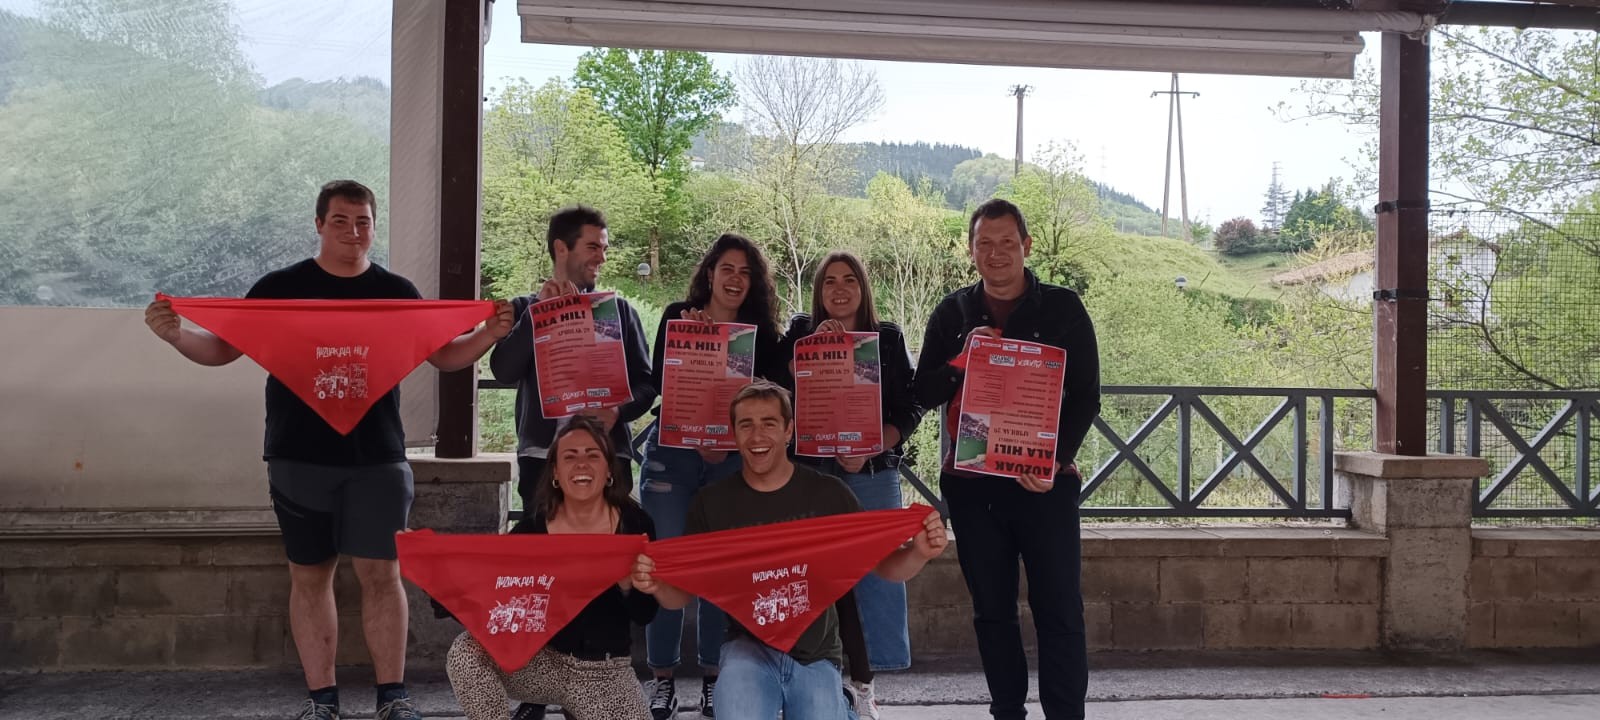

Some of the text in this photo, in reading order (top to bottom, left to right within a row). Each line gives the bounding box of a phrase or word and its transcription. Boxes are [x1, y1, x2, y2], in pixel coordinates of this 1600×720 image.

[533, 296, 581, 315] AUZUAK
[535, 316, 557, 330] ALA
[560, 310, 586, 322] HIL!
[668, 324, 720, 336] AUZUAK
[668, 339, 722, 352] ALA HIL!
[797, 335, 845, 346] AUZUAK
[797, 350, 847, 361] ALA HIL!
[994, 443, 1054, 460] ALA HIL!
[995, 461, 1053, 476] AUZUAK
